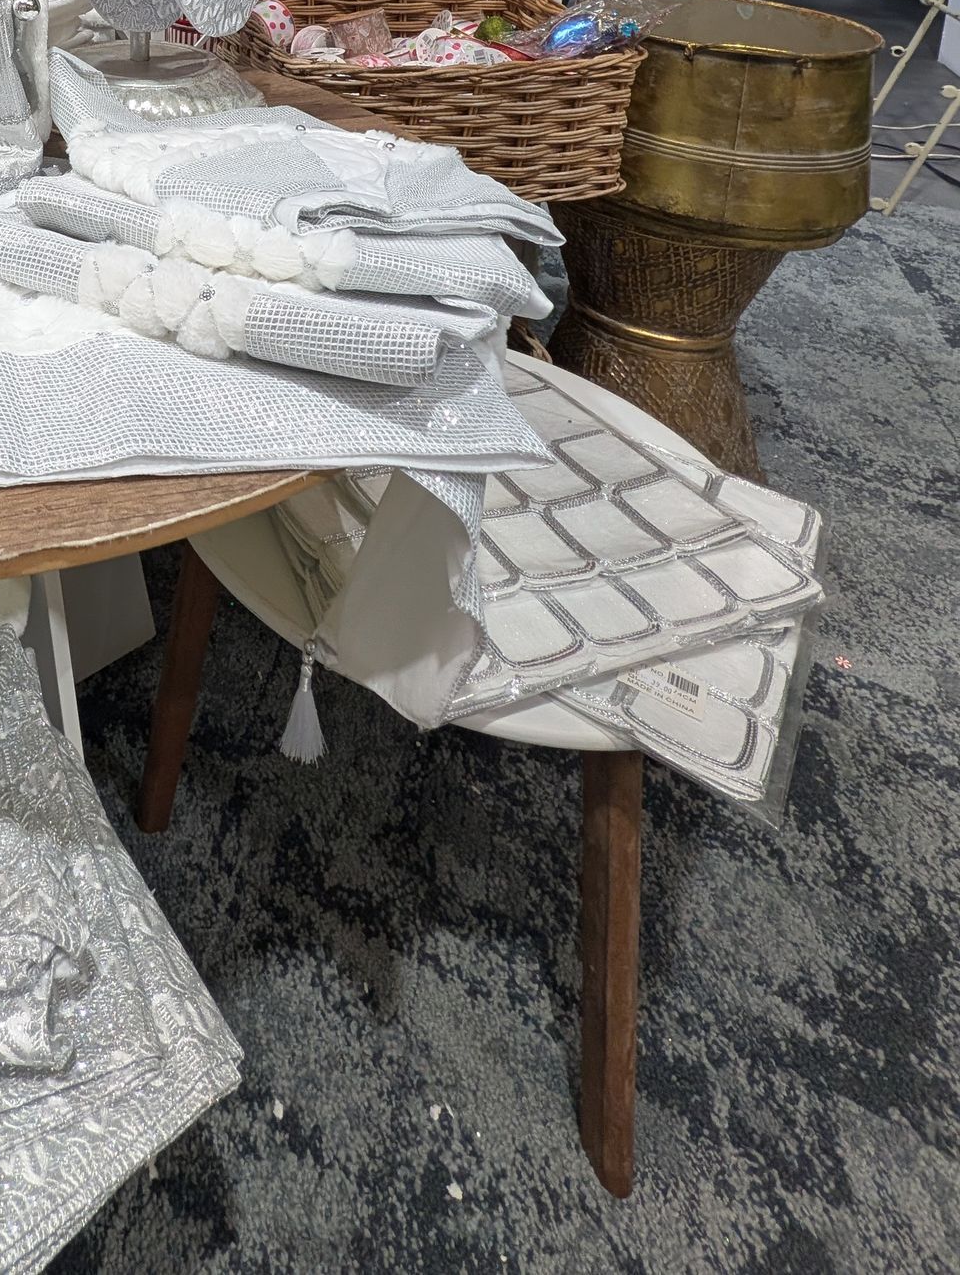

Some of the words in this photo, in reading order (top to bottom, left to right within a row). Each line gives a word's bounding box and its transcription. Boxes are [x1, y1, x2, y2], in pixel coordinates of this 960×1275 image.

[627, 677, 652, 693] MADE
[654, 690, 664, 699] IN
[665, 696, 695, 715] CHINA
